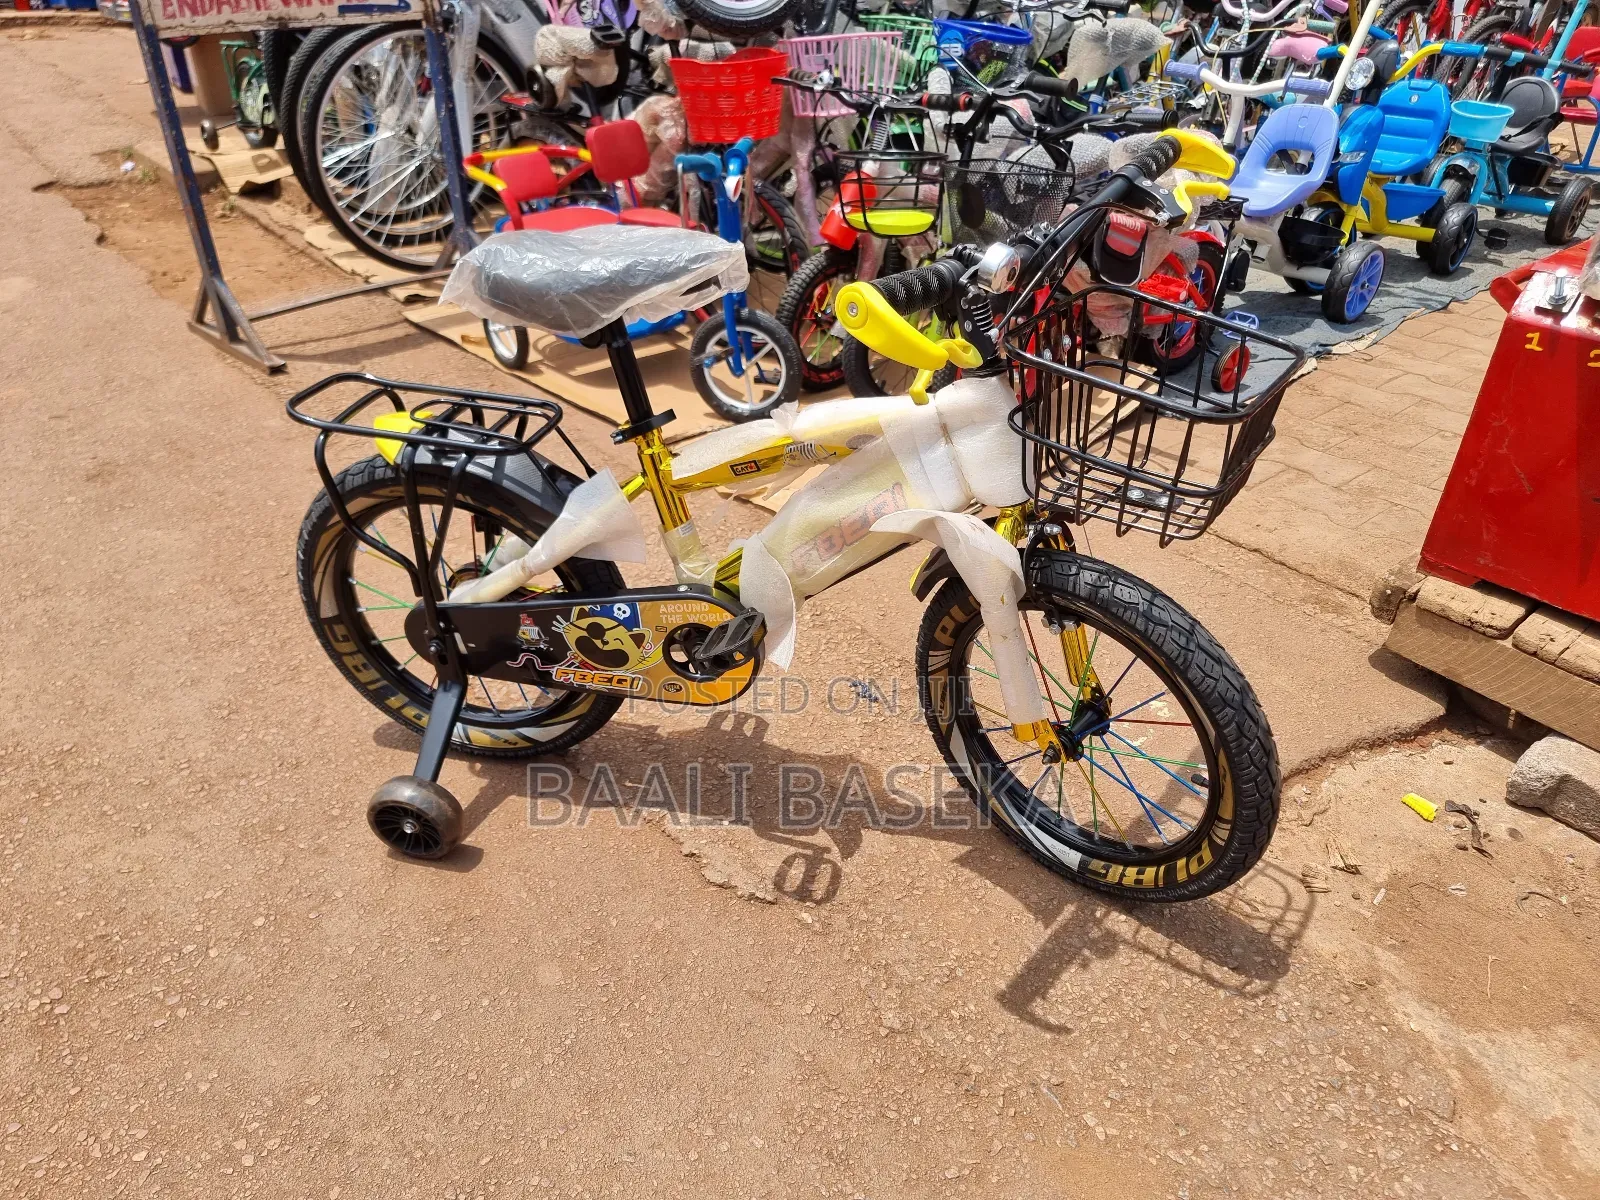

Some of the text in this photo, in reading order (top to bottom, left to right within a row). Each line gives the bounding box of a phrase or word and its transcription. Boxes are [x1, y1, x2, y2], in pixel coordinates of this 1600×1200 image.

[1524, 332, 1543, 351] 1
[660, 603, 709, 613] AROUND
[660, 612, 731, 624] THE WORLD
